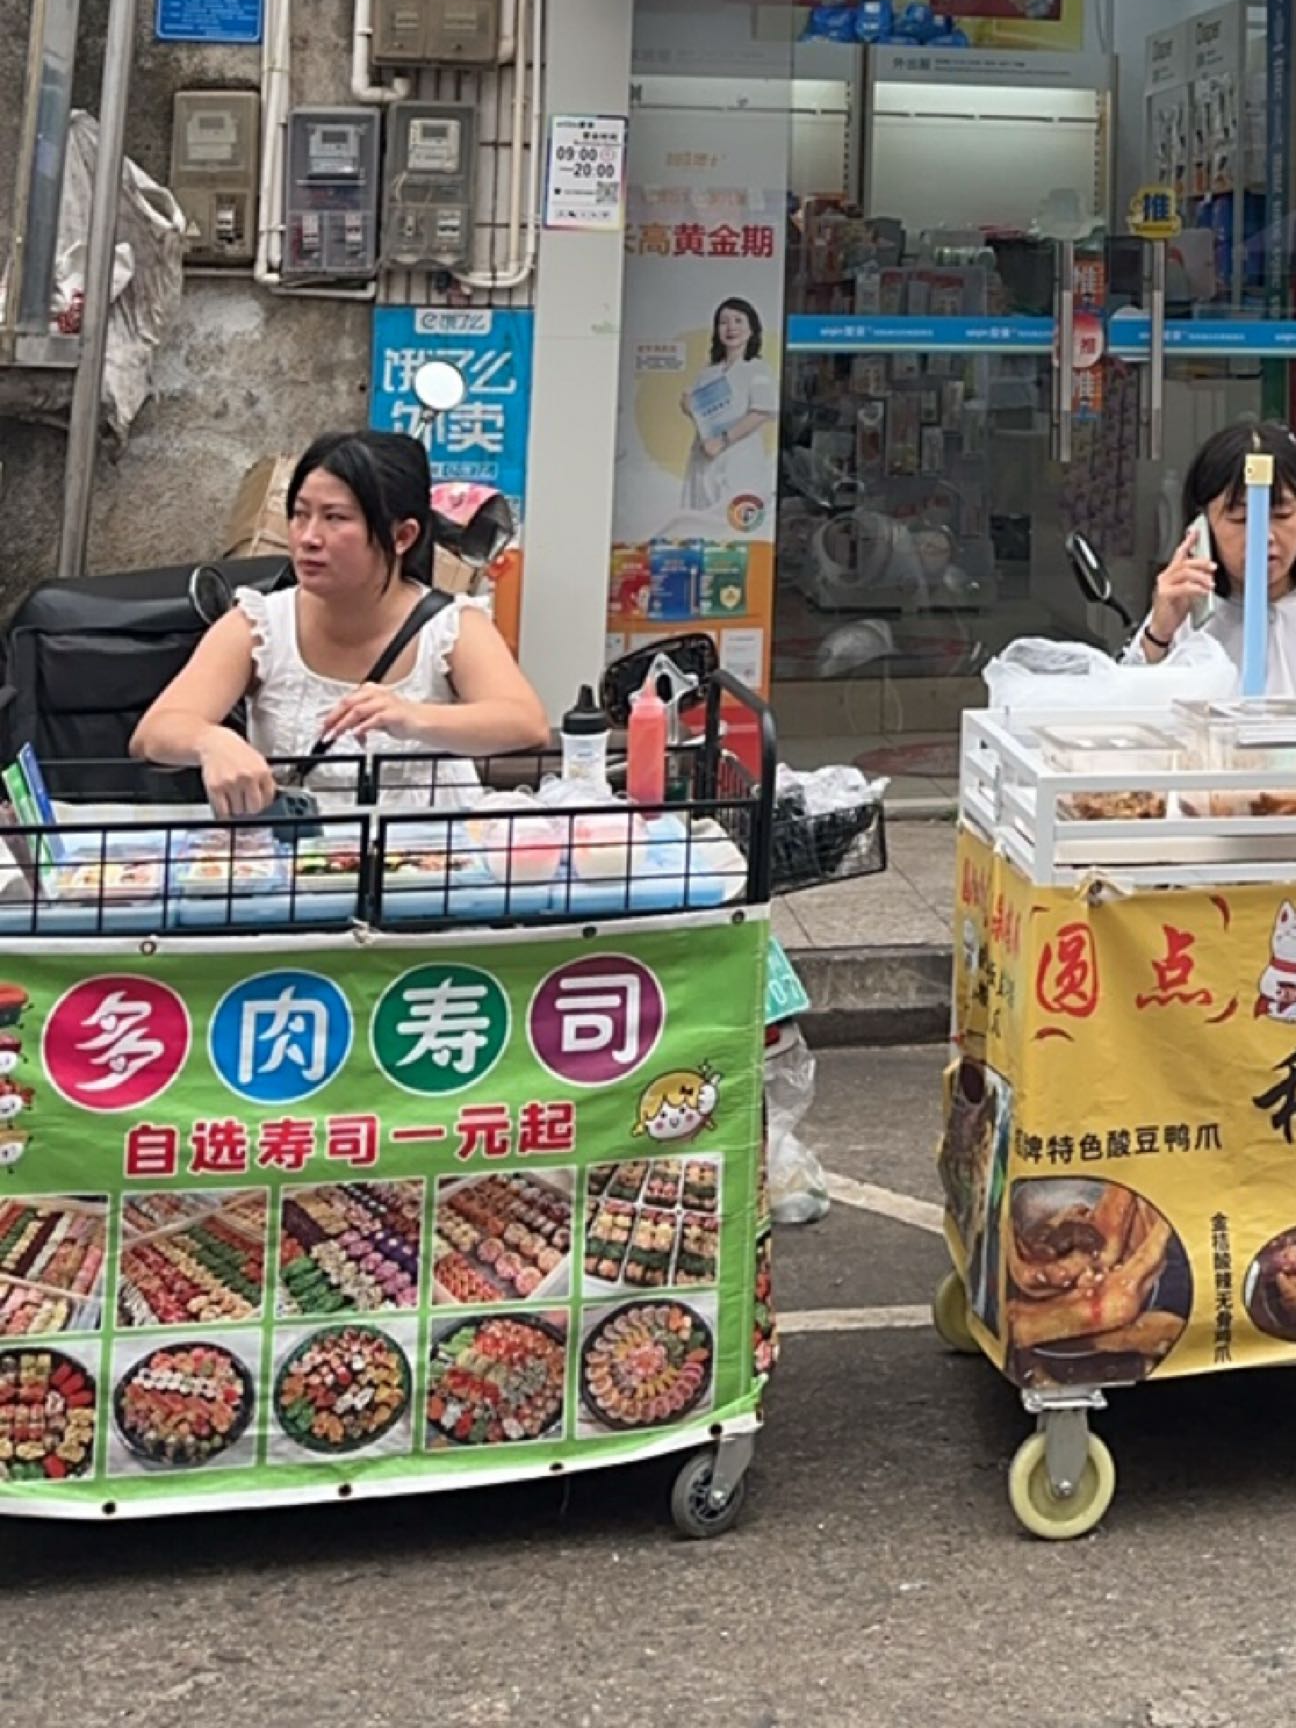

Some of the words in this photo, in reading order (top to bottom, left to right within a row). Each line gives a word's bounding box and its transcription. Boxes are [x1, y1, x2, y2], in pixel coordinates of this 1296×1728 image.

[1035, 921, 1214, 1019] 圆点
[77, 975, 642, 1093] 多肉寿司
[123, 1101, 576, 1178] 自选寿司一元起
